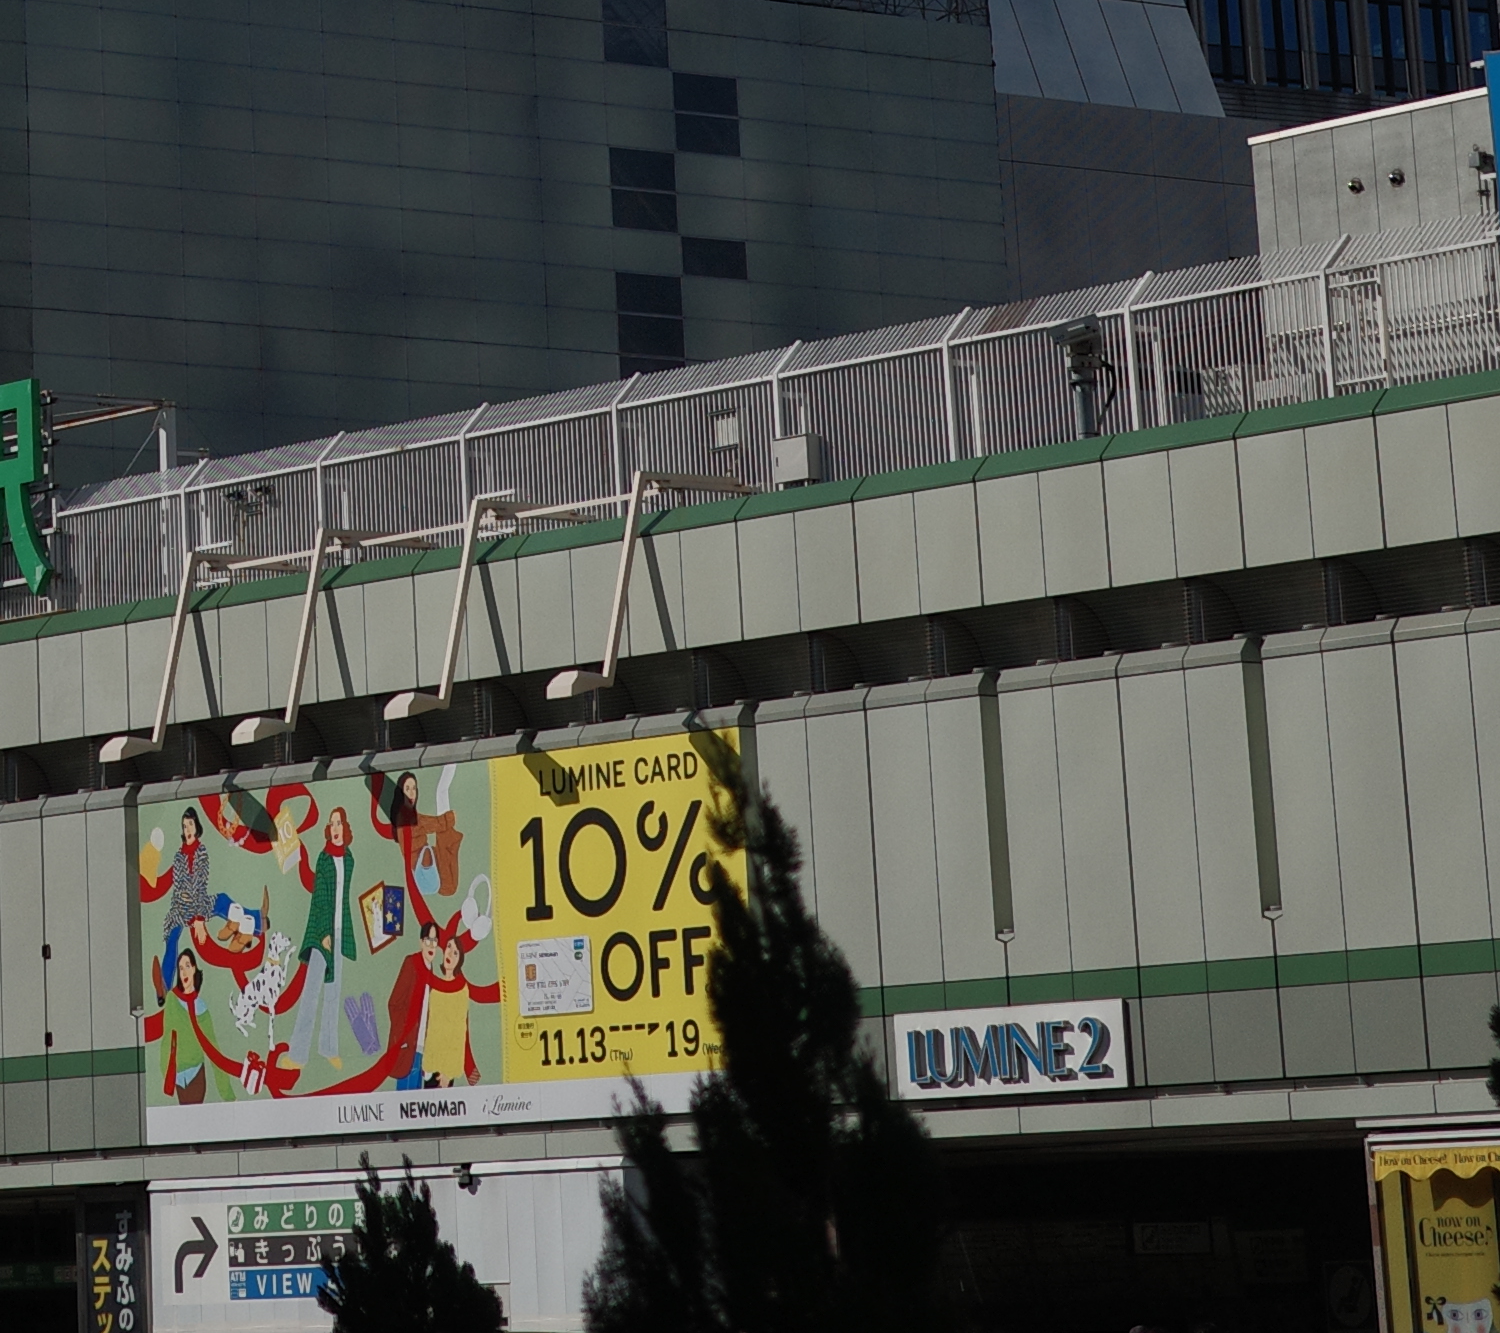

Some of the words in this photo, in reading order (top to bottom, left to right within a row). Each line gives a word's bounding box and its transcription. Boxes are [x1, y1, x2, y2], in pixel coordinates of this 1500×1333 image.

[538, 760, 626, 796] LUMINE
[634, 751, 698, 785] CARD
[520, 799, 722, 922] 10%
[600, 925, 712, 1002] OFF
[539, 1025, 607, 1066] 11.13
[609, 1048, 634, 1062] (Thu)
[665, 1018, 700, 1058] 19
[907, 1020, 1077, 1086] LUMINE
[1077, 1017, 1114, 1078] 2
[338, 1102, 385, 1124] LUMINE
[1436, 1216, 1463, 1228] now
[1465, 1215, 1481, 1228] on
[256, 1272, 313, 1296] VIEW
